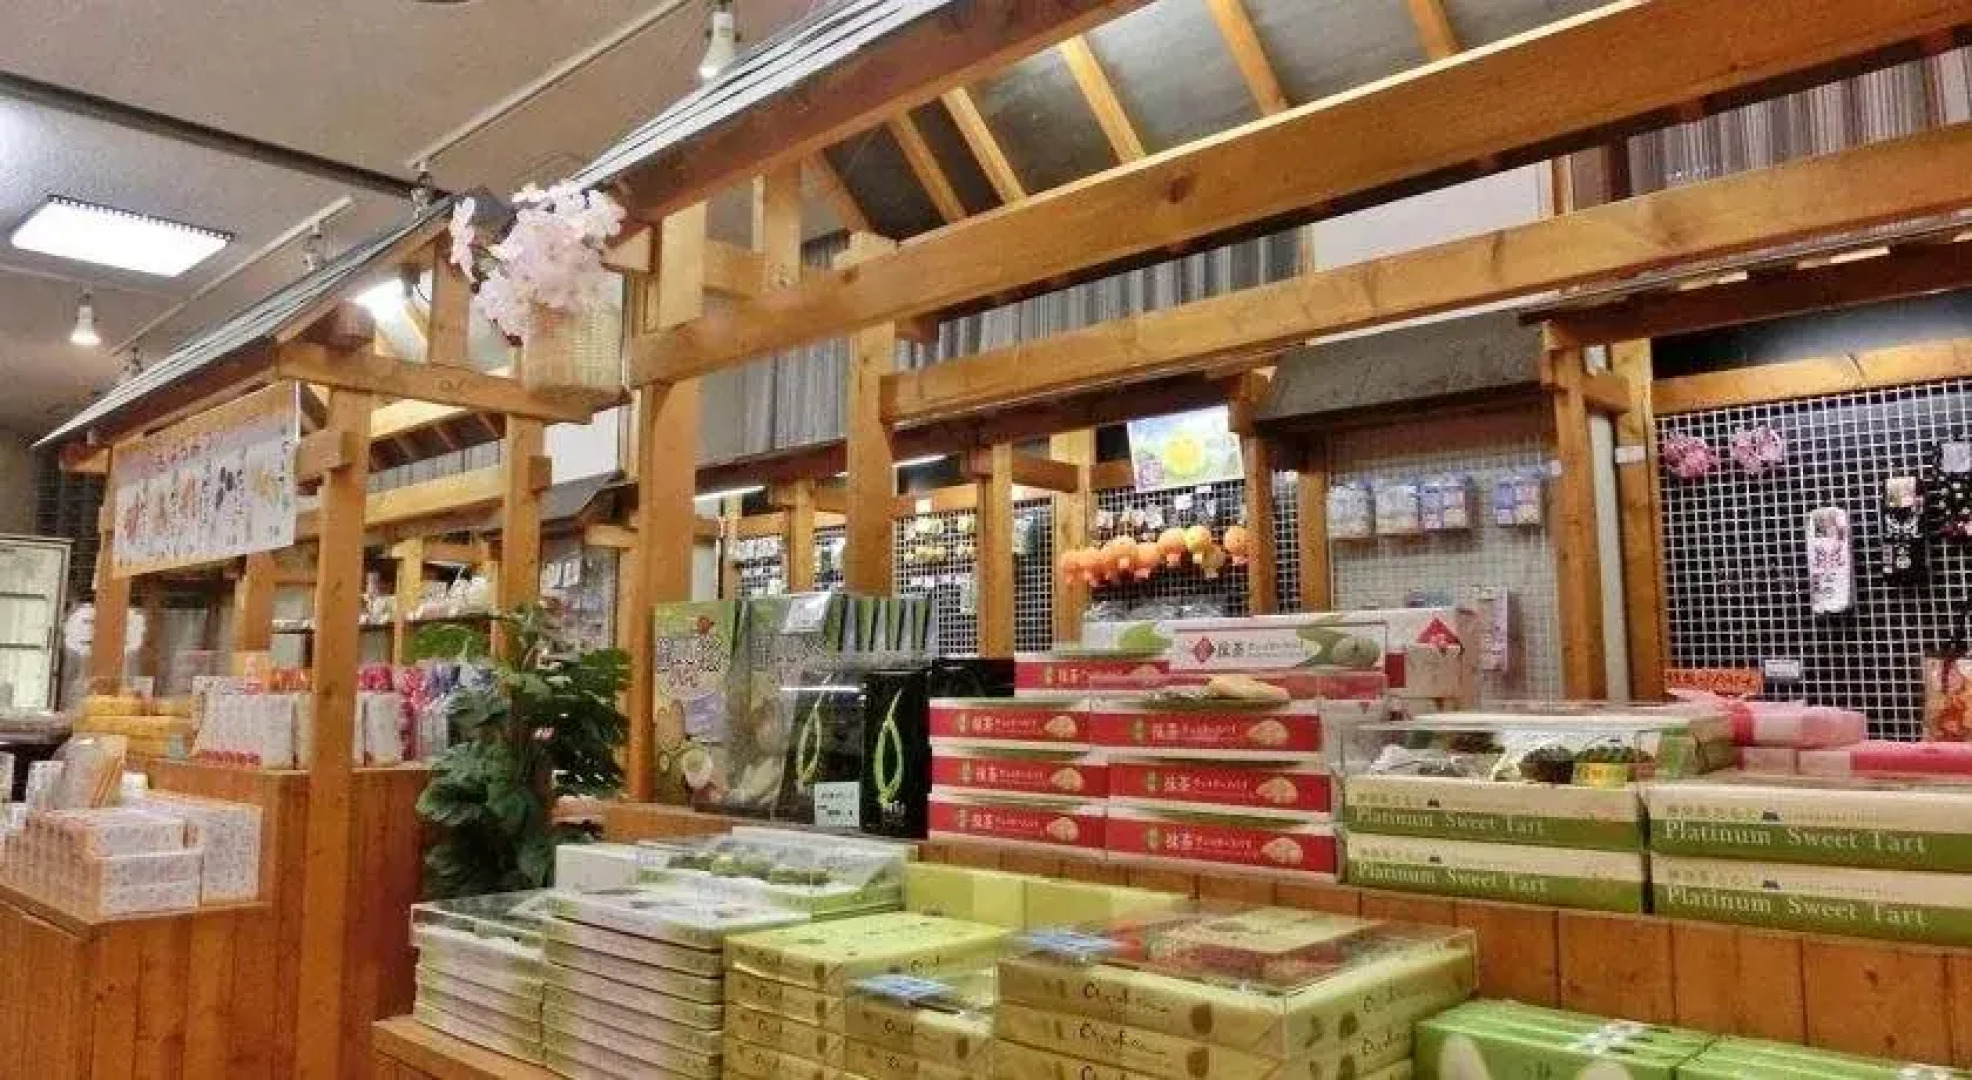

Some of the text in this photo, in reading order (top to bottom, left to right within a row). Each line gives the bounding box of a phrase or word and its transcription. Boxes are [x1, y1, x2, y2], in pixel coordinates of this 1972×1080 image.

[1356, 807, 1544, 836] Platinum Sweet Tart
[1665, 821, 1927, 853] Platinum Sweet Tart
[1358, 861, 1548, 893] Platinum Sweet Tart
[1667, 886, 1927, 925] Platinum Sweet Tart
